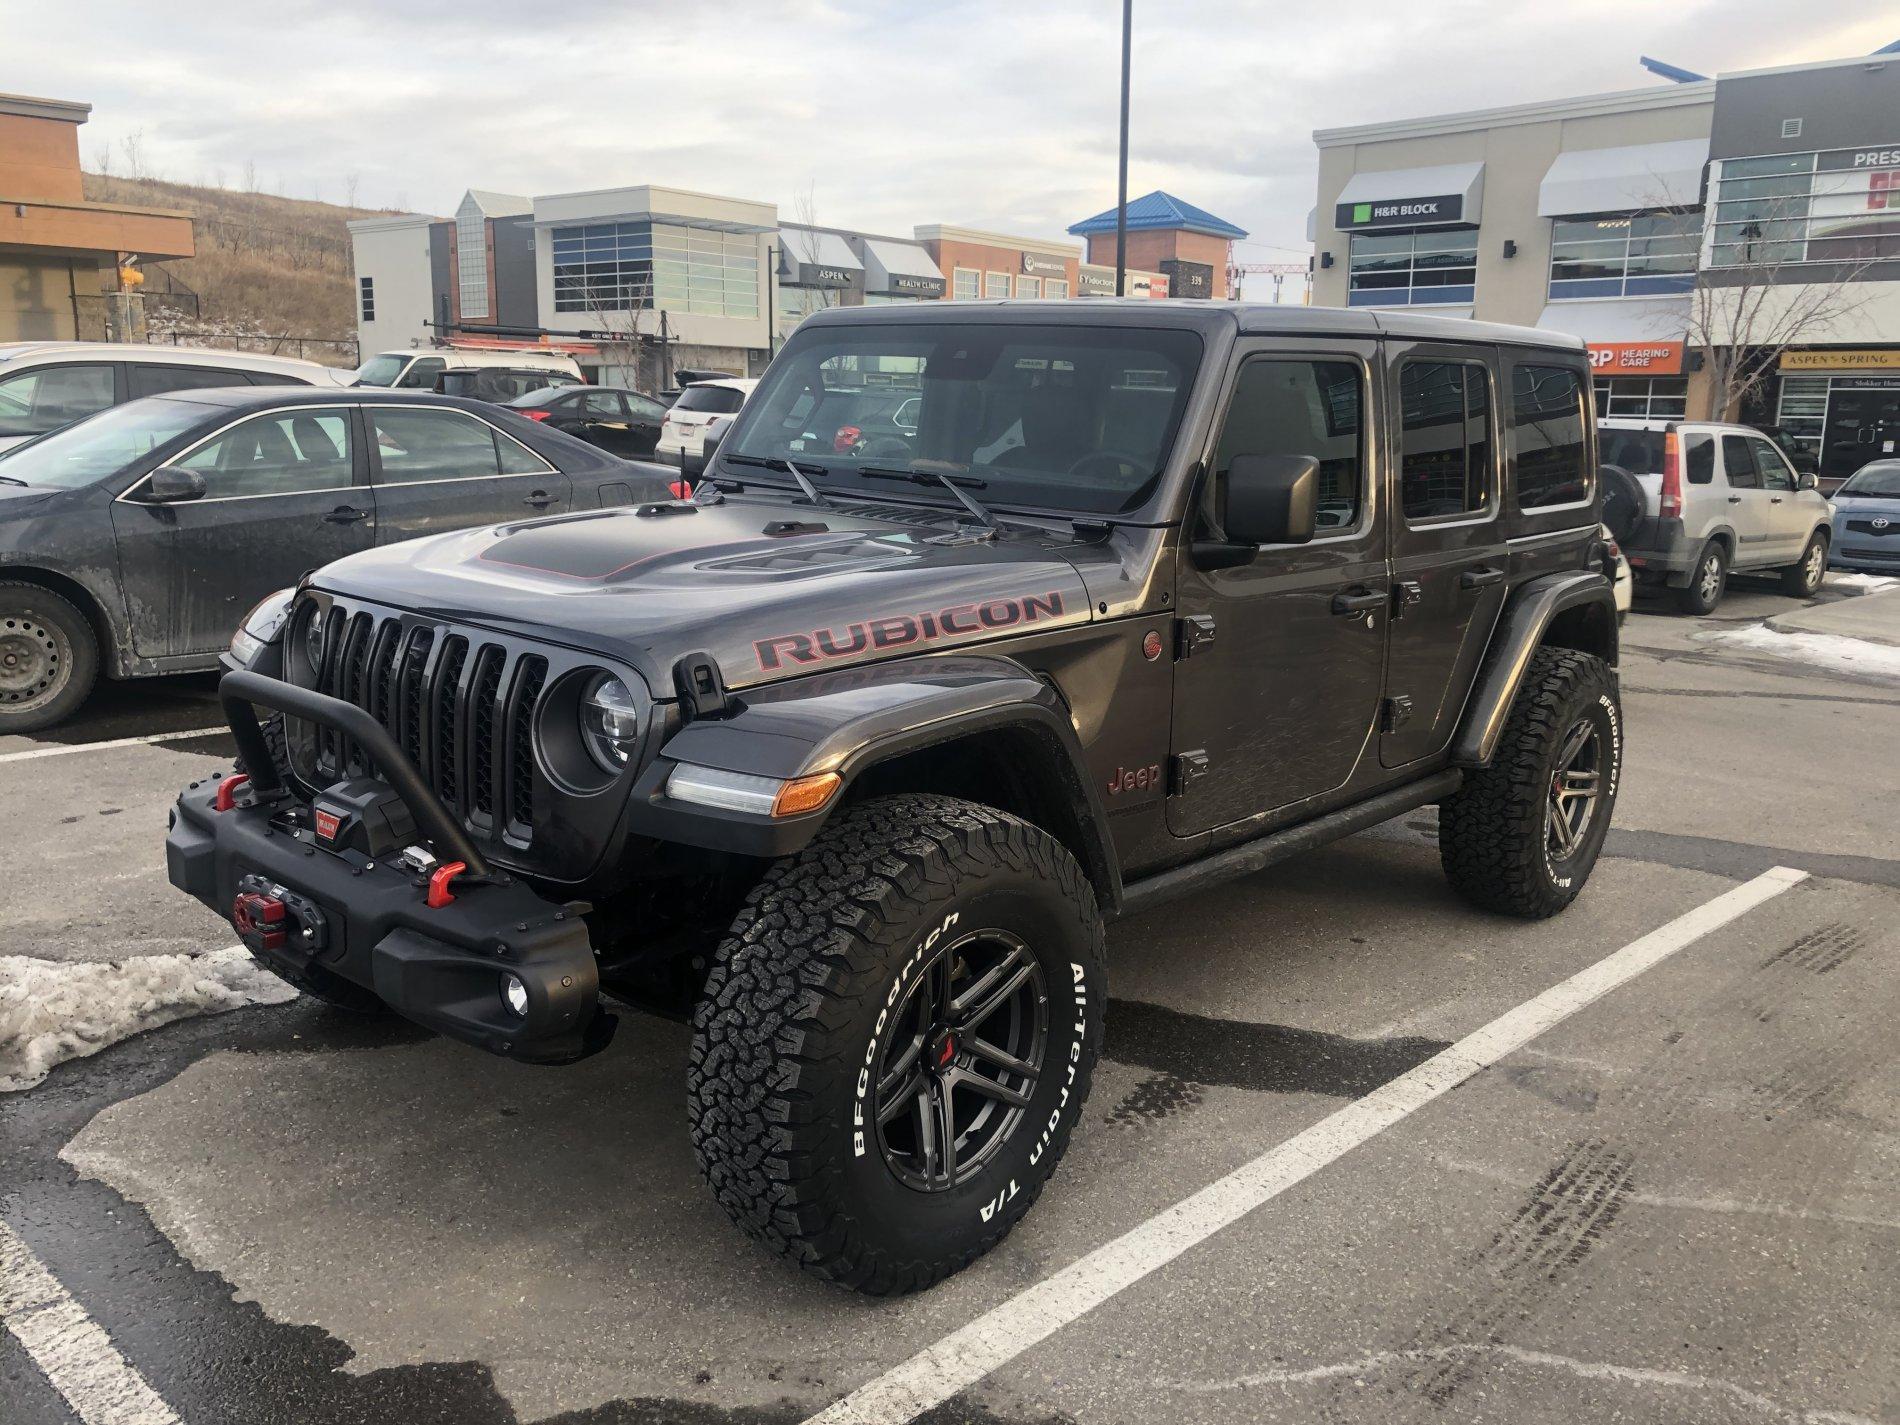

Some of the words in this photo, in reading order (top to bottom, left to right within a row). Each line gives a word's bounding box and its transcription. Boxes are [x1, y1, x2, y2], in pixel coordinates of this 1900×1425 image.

[1854, 150, 1900, 166] PRES
[1374, 205, 1398, 217] H&R
[1400, 203, 1438, 215] BLOCK
[819, 269, 844, 280] ASPEN
[1191, 275, 1202, 285] 339
[898, 279, 920, 288] HEALTH
[921, 281, 941, 291] CLINIC
[1620, 348, 1670, 358] HEARING
[1789, 355, 1827, 365] ASPEN
[1841, 354, 1888, 364] SPRING
[1620, 358, 1650, 367] CARE
[752, 591, 1065, 672] RUBICON
[1599, 695, 1620, 796] BFGoodrich
[1107, 765, 1160, 796] Jeep
[854, 912, 960, 1157] BFGoodrich
[1029, 962, 1086, 1166] All-Terrain
[980, 1179, 1020, 1222] T/A
